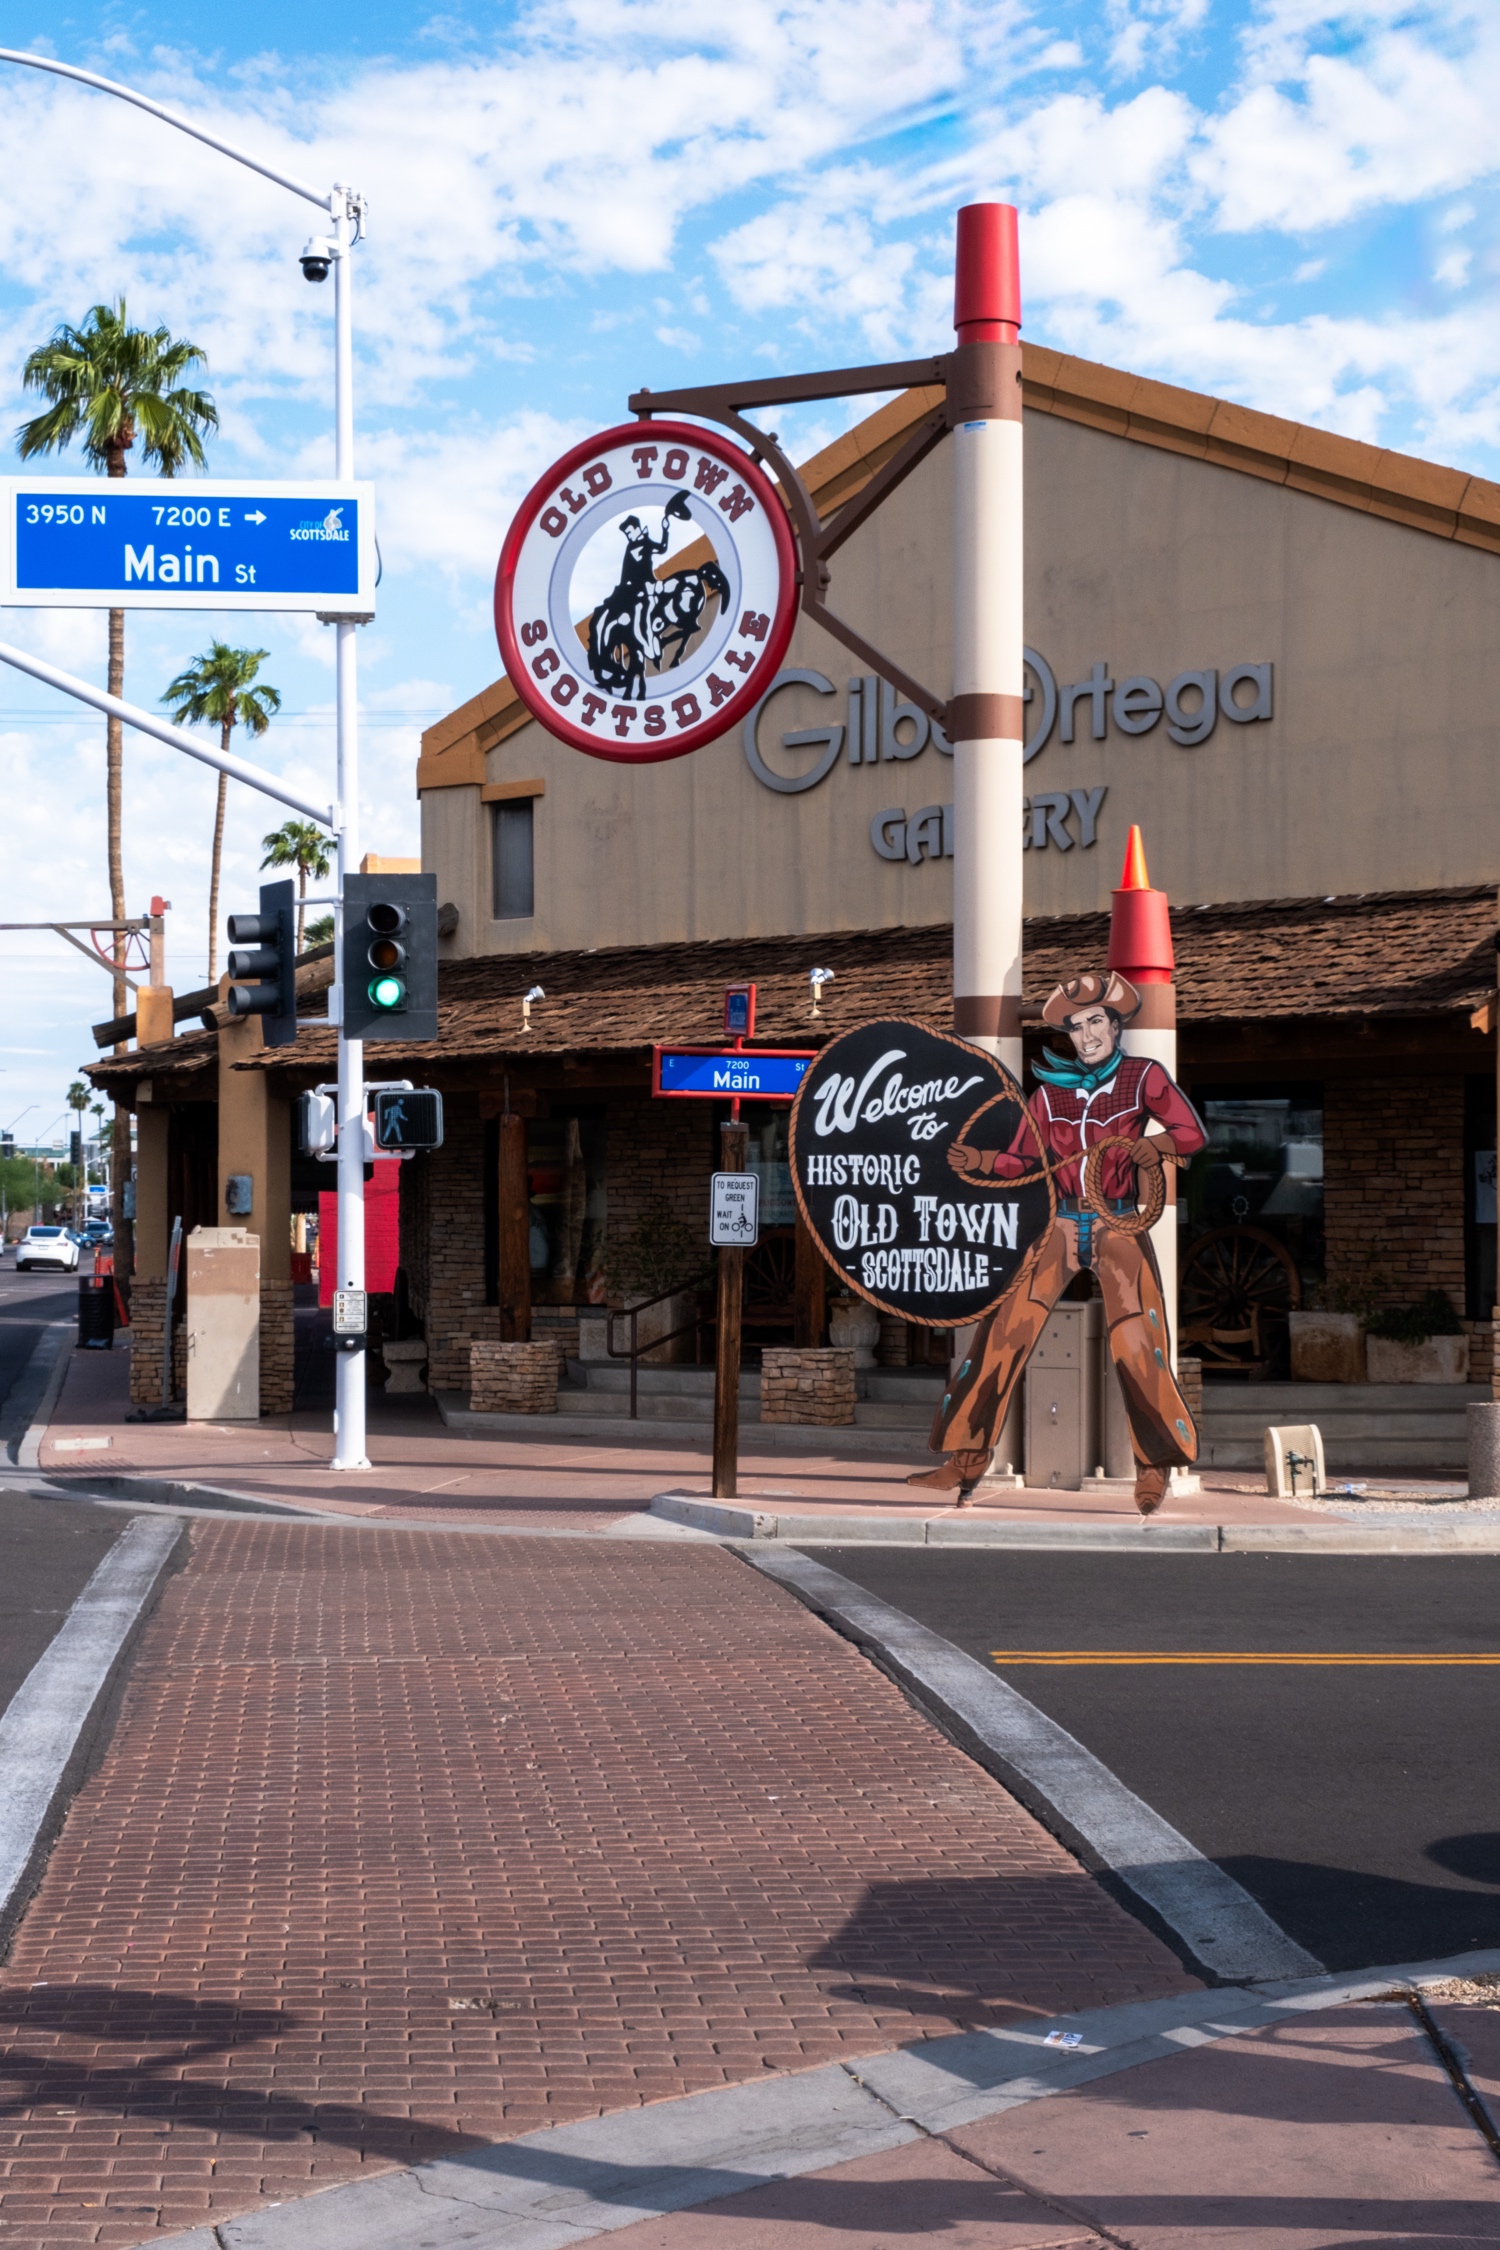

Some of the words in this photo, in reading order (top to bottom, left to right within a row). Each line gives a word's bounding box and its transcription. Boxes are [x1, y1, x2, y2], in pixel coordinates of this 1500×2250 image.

[540, 462, 612, 537] OLD
[632, 446, 755, 523] TOWN
[26, 504, 84, 525] 3950
[92, 505, 106, 525] N
[151, 506, 211, 527] 7200
[218, 507, 231, 527] E
[300, 520, 313, 530] CITY
[290, 529, 349, 541] SCOTTSDALE
[125, 544, 219, 583] Main
[235, 564, 256, 584] St
[521, 610, 770, 737] SCOTTSDALE
[744, 668, 1034, 793] Gilb
[871, 786, 1108, 865] GARY
[726, 1060, 750, 1070] 7200
[795, 1063, 805, 1071] St
[713, 1071, 760, 1090] Main
[814, 1049, 984, 1136] Welcome
[907, 1112, 949, 1141] to
[717, 1181, 725, 1190] TO
[727, 1181, 754, 1191] REQUEST
[807, 1154, 921, 1195] HISTORIC
[725, 1193, 745, 1202] GREEN
[717, 1210, 733, 1219] WAIT
[719, 1222, 730, 1231] ON
[831, 1194, 899, 1251] OLD
[913, 1195, 1020, 1250] TOWN
[861, 1246, 990, 1292] SCOTTSDALE
